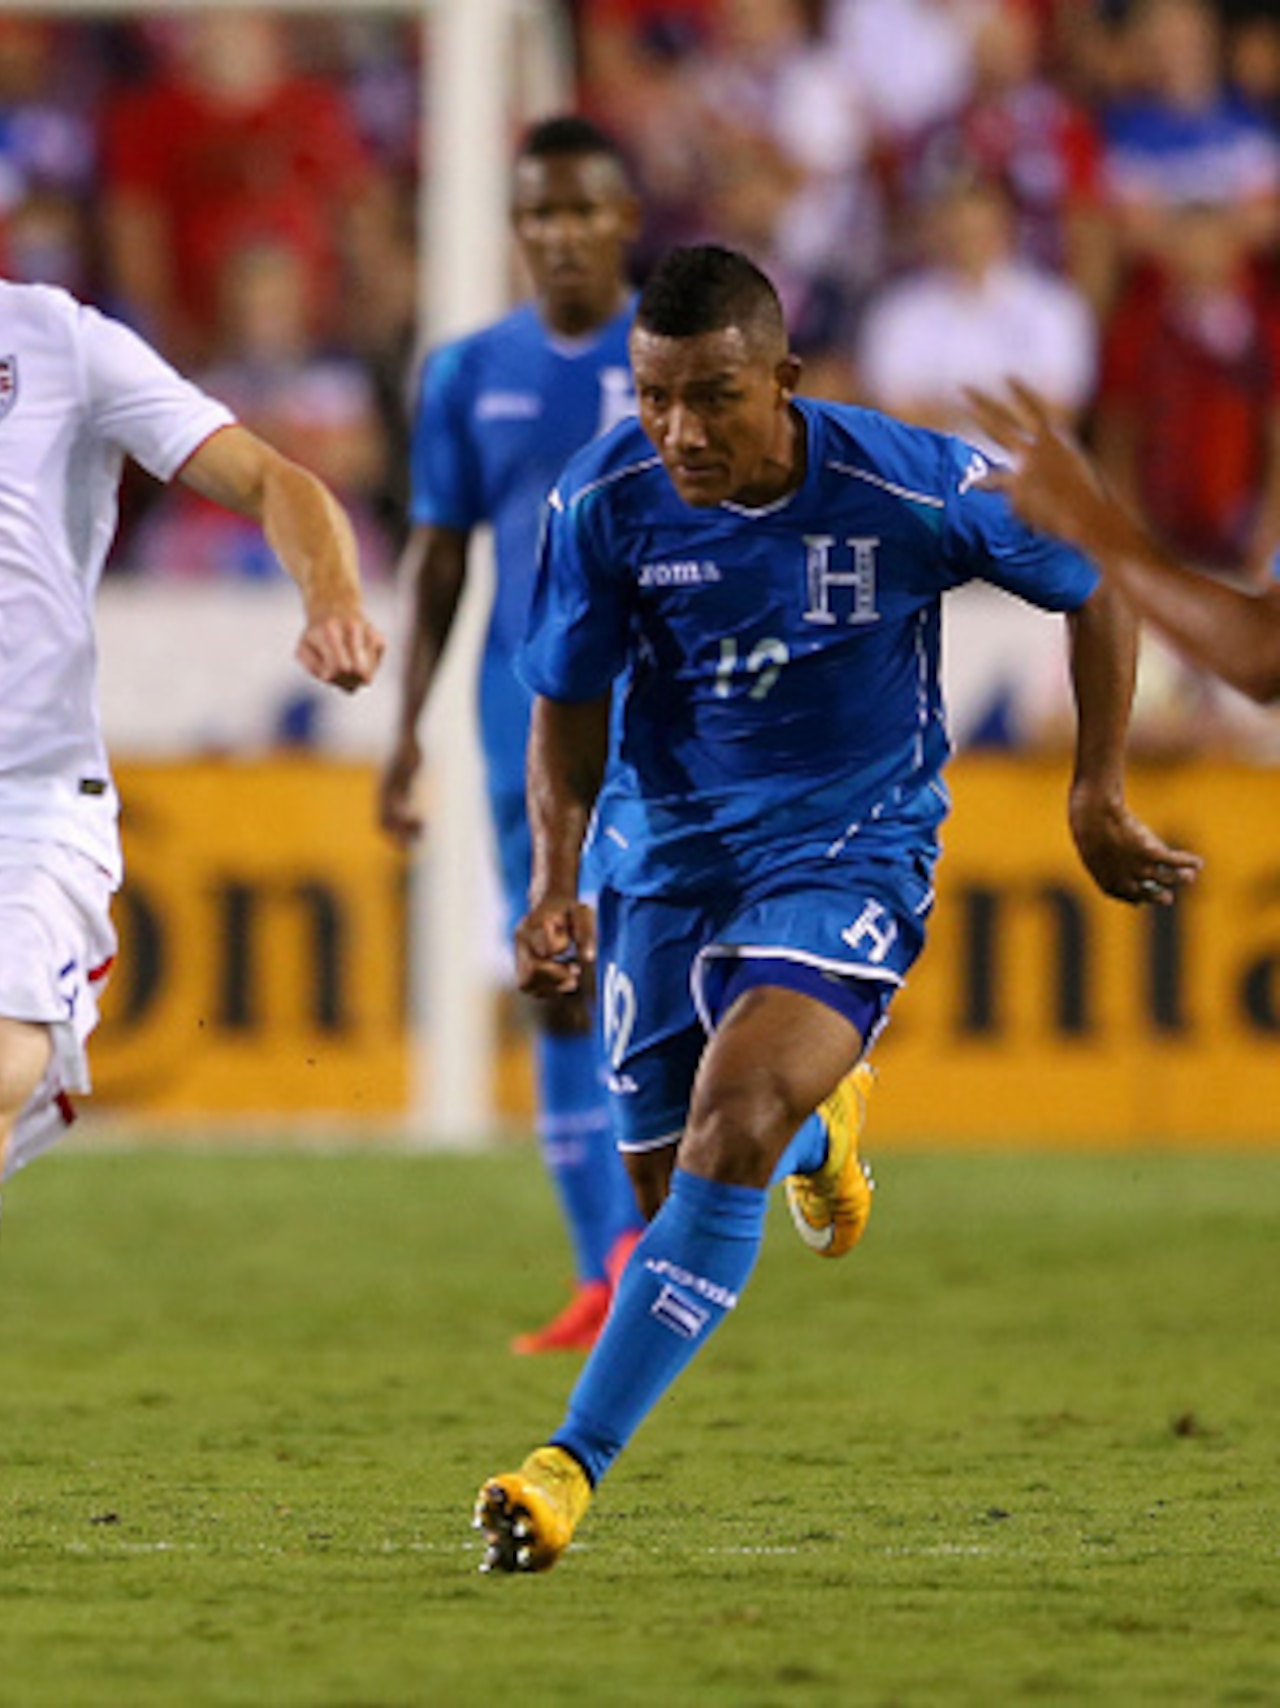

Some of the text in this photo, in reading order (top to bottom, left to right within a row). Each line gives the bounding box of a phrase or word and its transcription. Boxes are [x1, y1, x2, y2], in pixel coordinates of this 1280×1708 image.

[802, 534, 881, 625] H
[716, 637, 790, 700] 19
[841, 898, 898, 963] H
